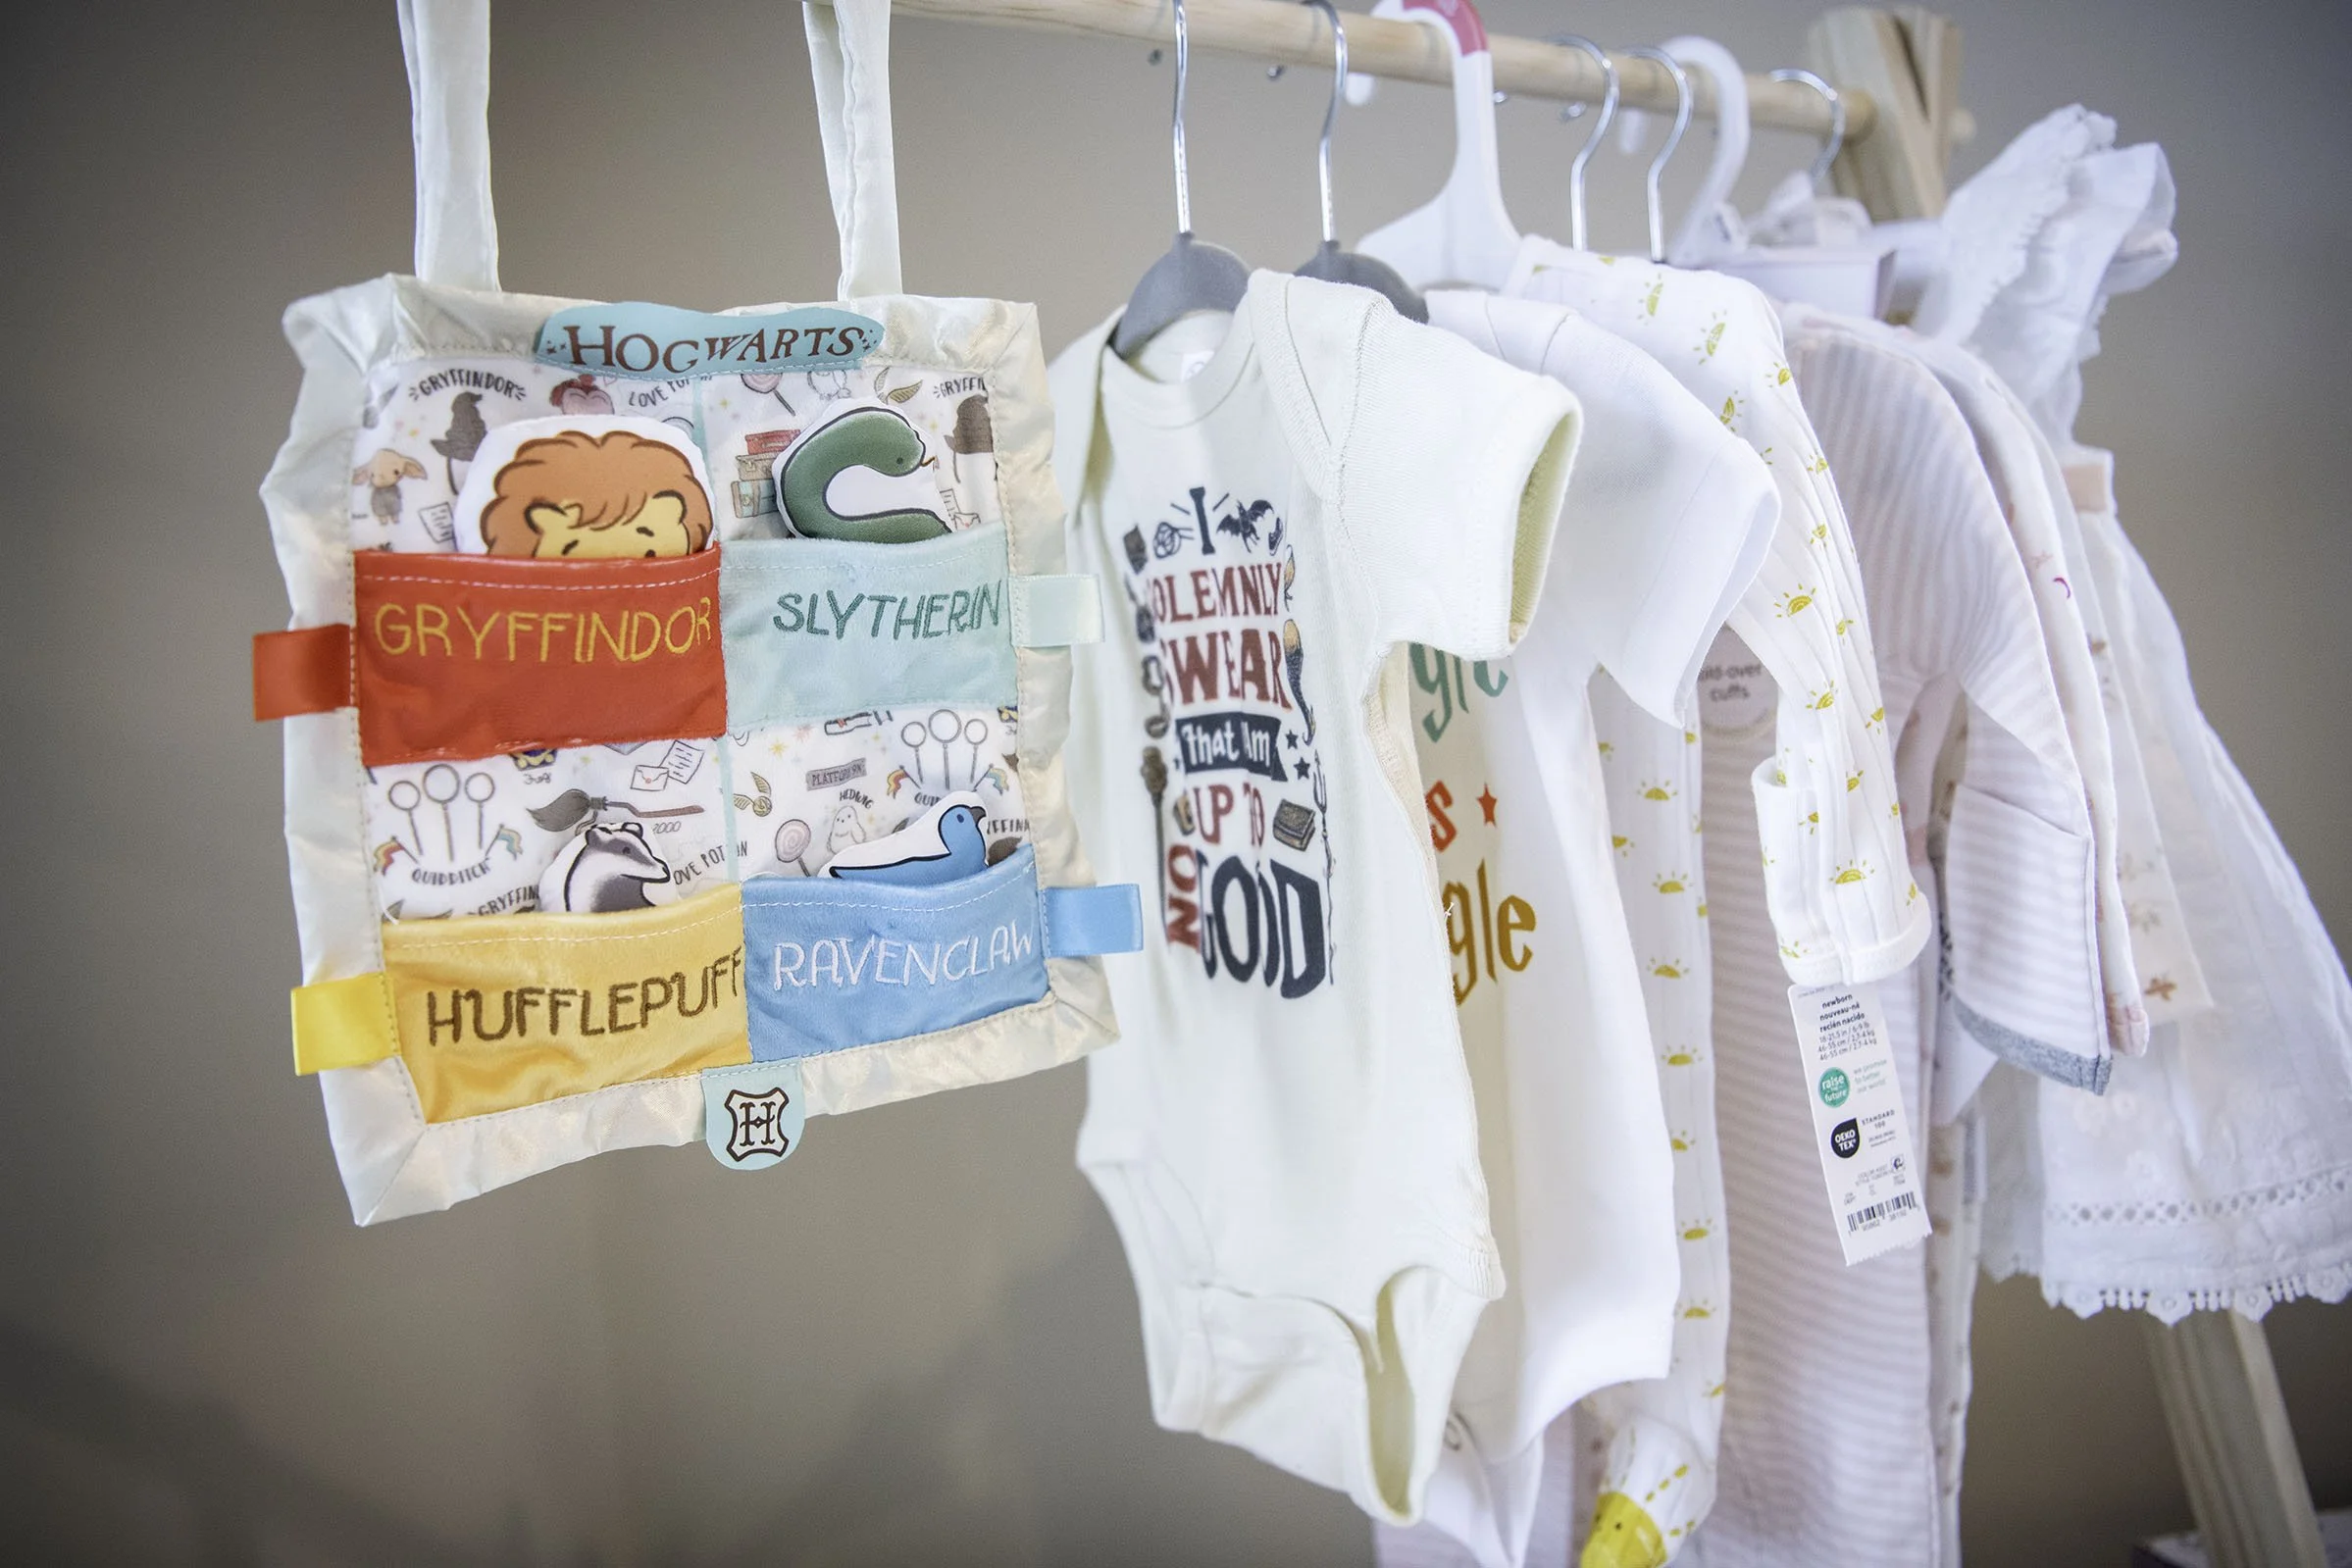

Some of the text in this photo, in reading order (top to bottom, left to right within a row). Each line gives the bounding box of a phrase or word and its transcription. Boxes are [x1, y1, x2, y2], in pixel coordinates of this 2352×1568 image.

[564, 325, 865, 373] HOGWARTS
[418, 369, 516, 397] GRYFFINDOR
[628, 385, 670, 408] LOVE
[1189, 486, 1216, 556] I
[1148, 562, 1283, 624] OLEMNLY
[773, 580, 1002, 640] SLYTHERIN
[375, 596, 711, 663] GRYFFINDOR
[839, 788, 875, 810] HEDWIG
[1193, 784, 1234, 845] UP
[411, 861, 491, 885] QUIDDITCH
[773, 919, 1034, 991] RAVENCLAW
[427, 944, 742, 1046] HUFFLEPUFF
[1821, 993, 1853, 1009] newborn
[1819, 1001, 1861, 1021] nouveau-né
[1842, 1012, 1866, 1024] nacido
[1821, 1075, 1844, 1090] raise
[1824, 1089, 1848, 1103] future
[1862, 1109, 1895, 1126] STANDARD
[1834, 1129, 1856, 1144] OEKO
